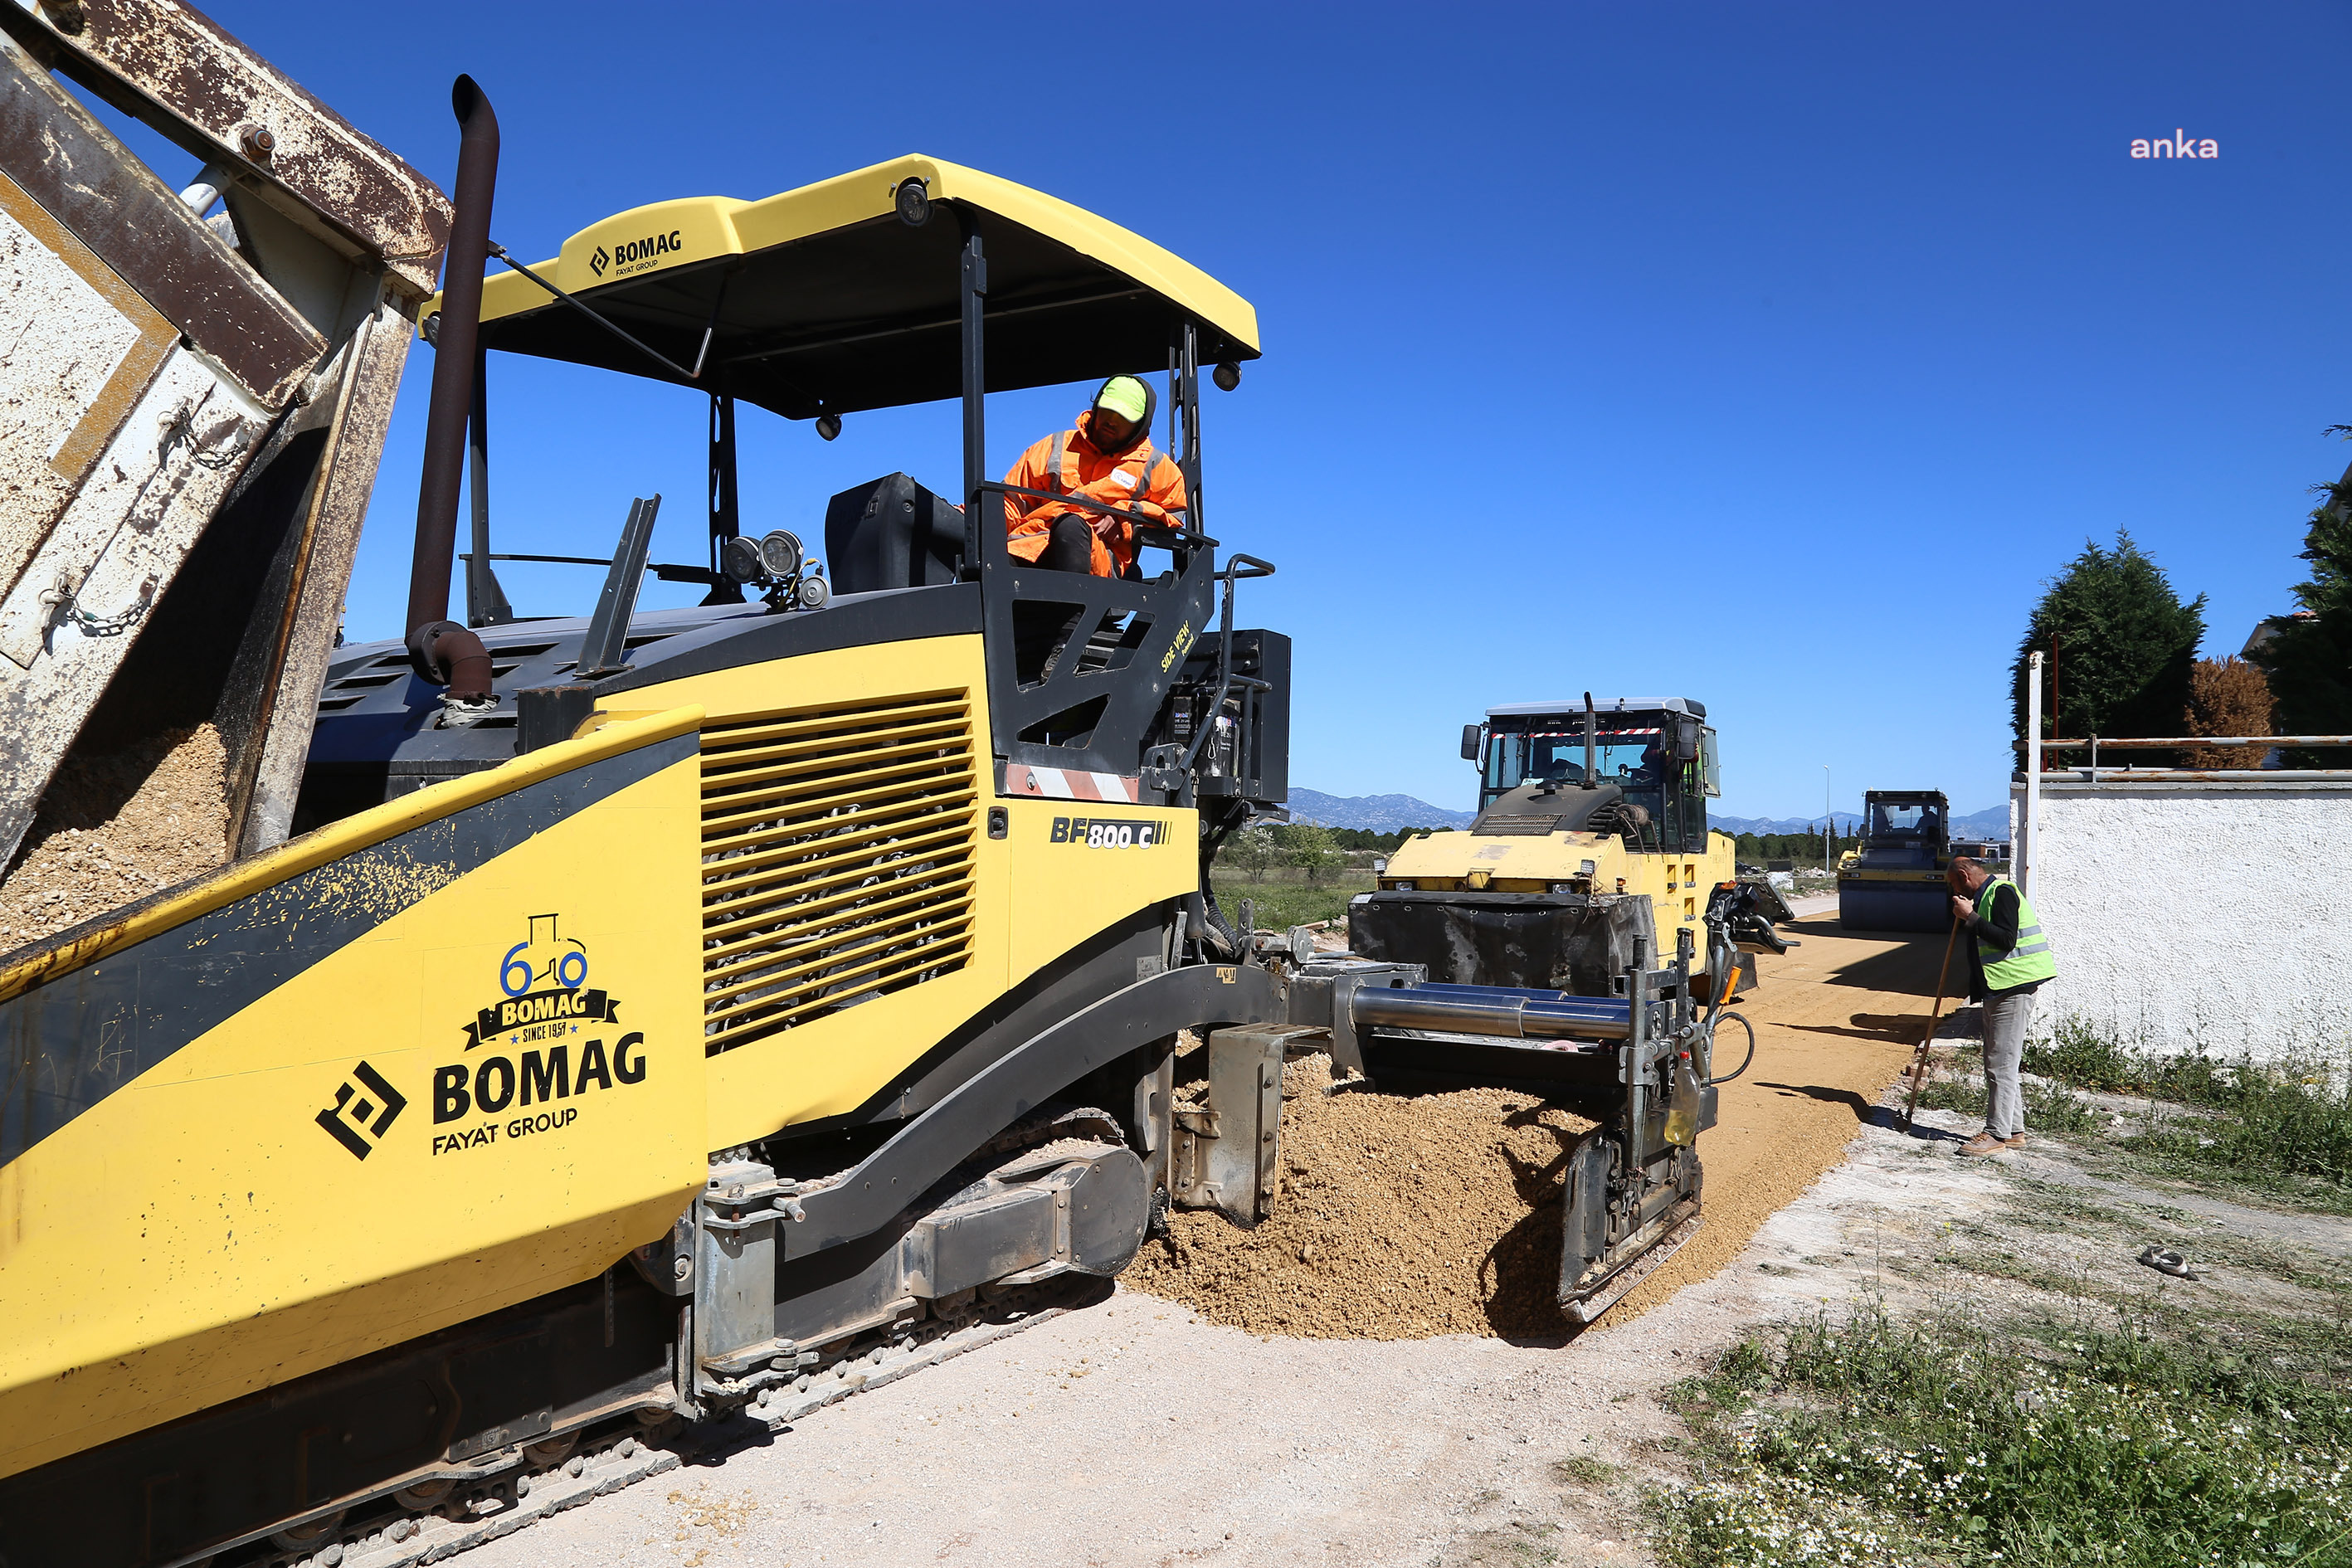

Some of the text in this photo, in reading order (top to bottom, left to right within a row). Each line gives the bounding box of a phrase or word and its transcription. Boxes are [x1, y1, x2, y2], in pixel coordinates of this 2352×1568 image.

[615, 230, 681, 265] BOMAG
[616, 260, 659, 276] FAYAT GROUP
[1161, 620, 1190, 673] SIDE VIEW
[502, 991, 587, 1026] BOMAG
[523, 1021, 567, 1042] SINCE 1957
[433, 1031, 646, 1125] BOMAG
[432, 1108, 577, 1156] FAYAT GROUP
